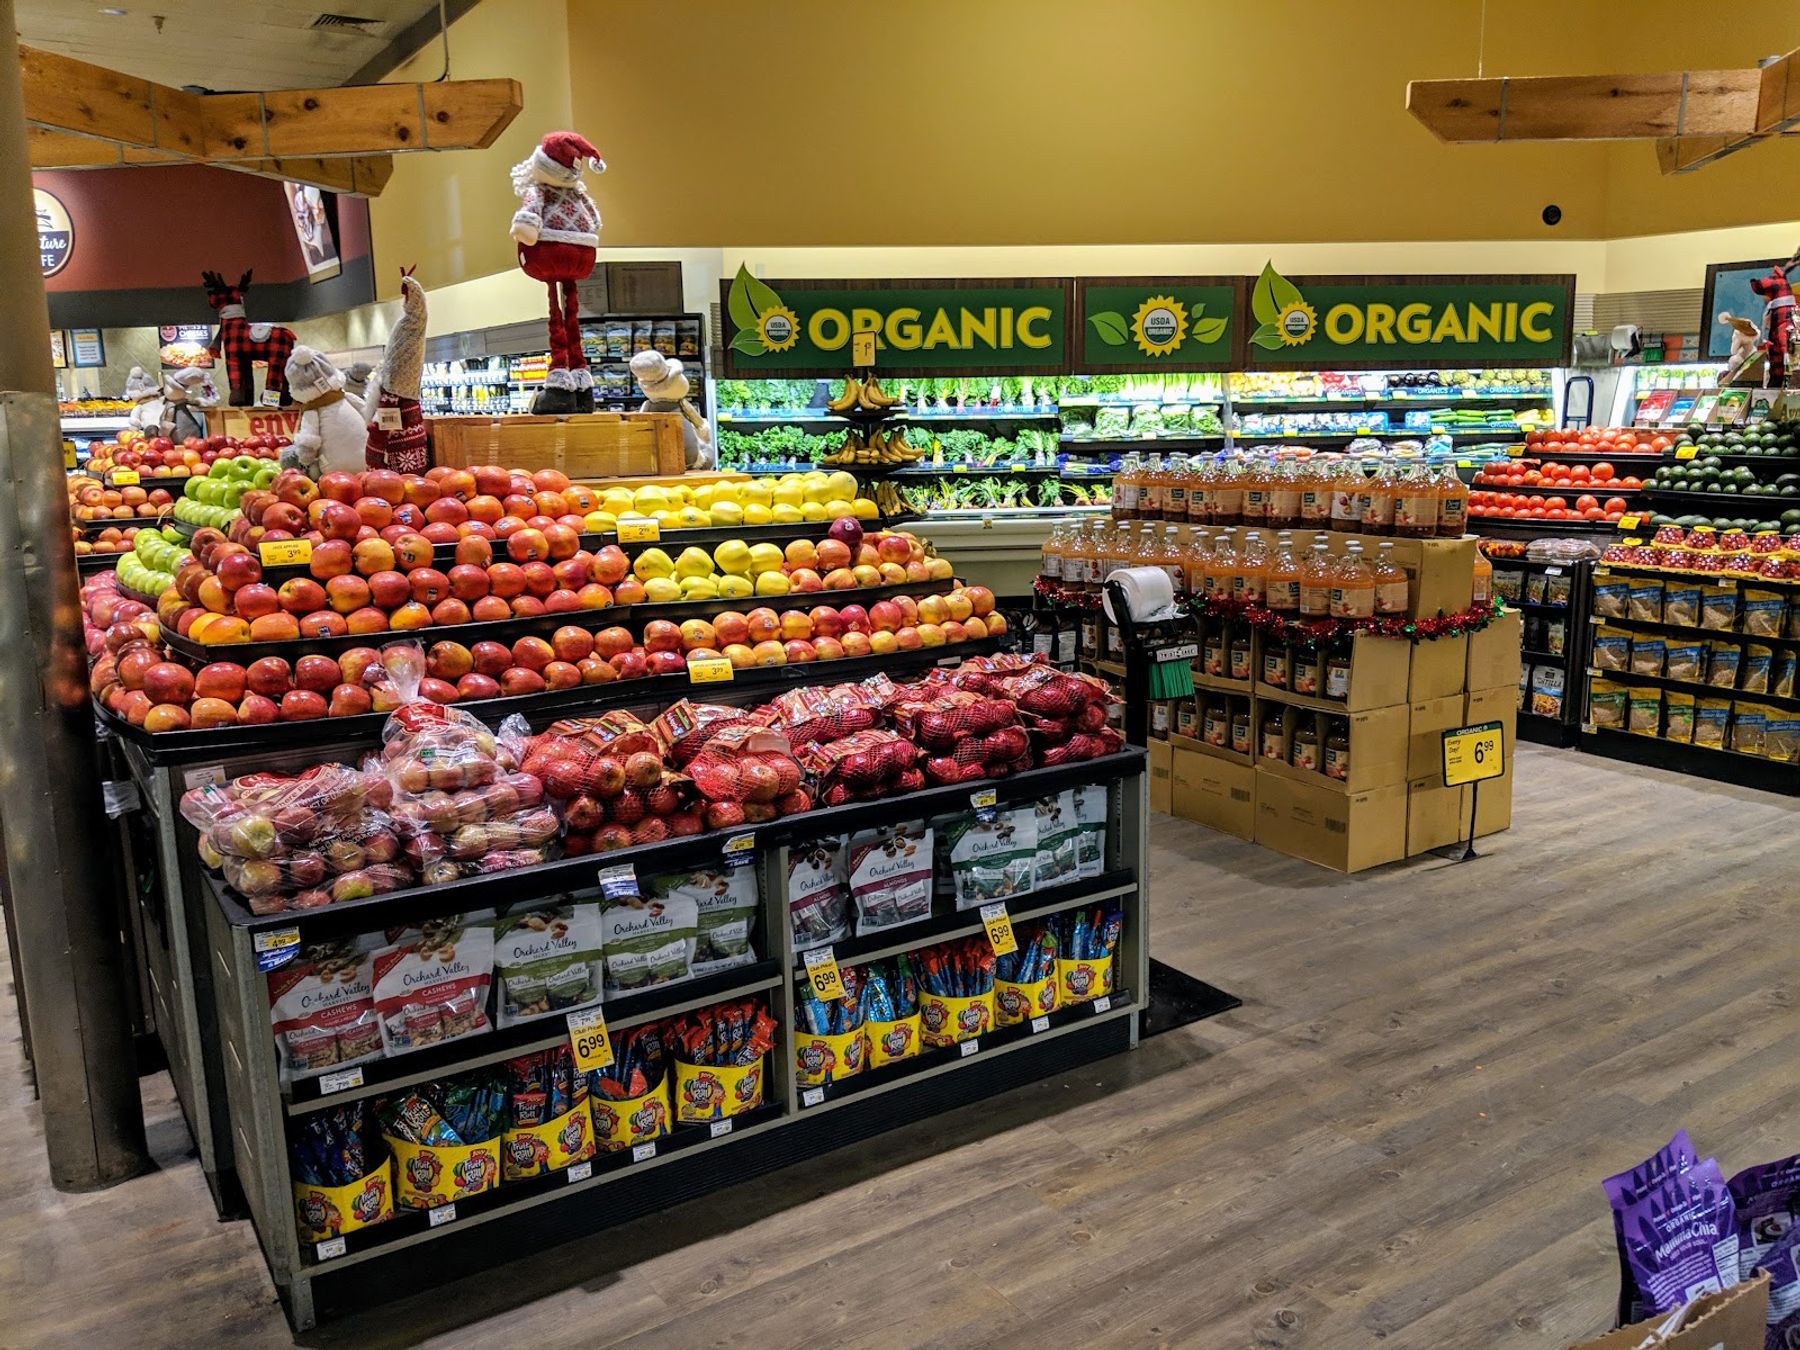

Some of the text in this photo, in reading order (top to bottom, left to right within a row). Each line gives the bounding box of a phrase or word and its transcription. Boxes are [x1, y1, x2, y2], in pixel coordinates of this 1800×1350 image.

[40, 254, 55, 267] FE
[770, 321, 787, 329] USDA
[1150, 317, 1170, 326] USDA
[1289, 316, 1305, 324] USDA
[1324, 302, 1554, 345] ORGANIC
[768, 329, 789, 337] ORGANIC
[807, 306, 1052, 351] ORGANIC
[1147, 327, 1173, 336] ORGANIC
[1417, 387, 1449, 395] ORGANICS
[250, 412, 301, 437] env
[1456, 725, 1483, 736] ORGANIC
[1474, 740, 1494, 764] 699
[715, 894, 737, 907] Valley
[614, 914, 674, 935] Orchard Valley
[991, 924, 1009, 944] 699
[513, 942, 551, 958] Orchard
[551, 937, 578, 949] Valley
[403, 962, 470, 986] Orchard Valley
[814, 970, 836, 991] 699
[342, 981, 371, 995] Valley
[422, 983, 457, 997] CASHEWS
[321, 1004, 358, 1019] CASHEWS
[578, 1033, 605, 1058] 699
[692, 1081, 711, 1089] Fruit
[693, 1088, 710, 1100] Roll
[518, 1102, 537, 1111] Fruit
[519, 1110, 536, 1119] Roll
[512, 1139, 531, 1151] Fruit
[515, 1148, 531, 1162] Roll
[414, 1159, 431, 1169] Fruit
[464, 1160, 484, 1171] Fruit
[415, 1168, 431, 1182] Roll
[465, 1170, 483, 1185] Roll
[1665, 1211, 1697, 1233] ORGANIC
